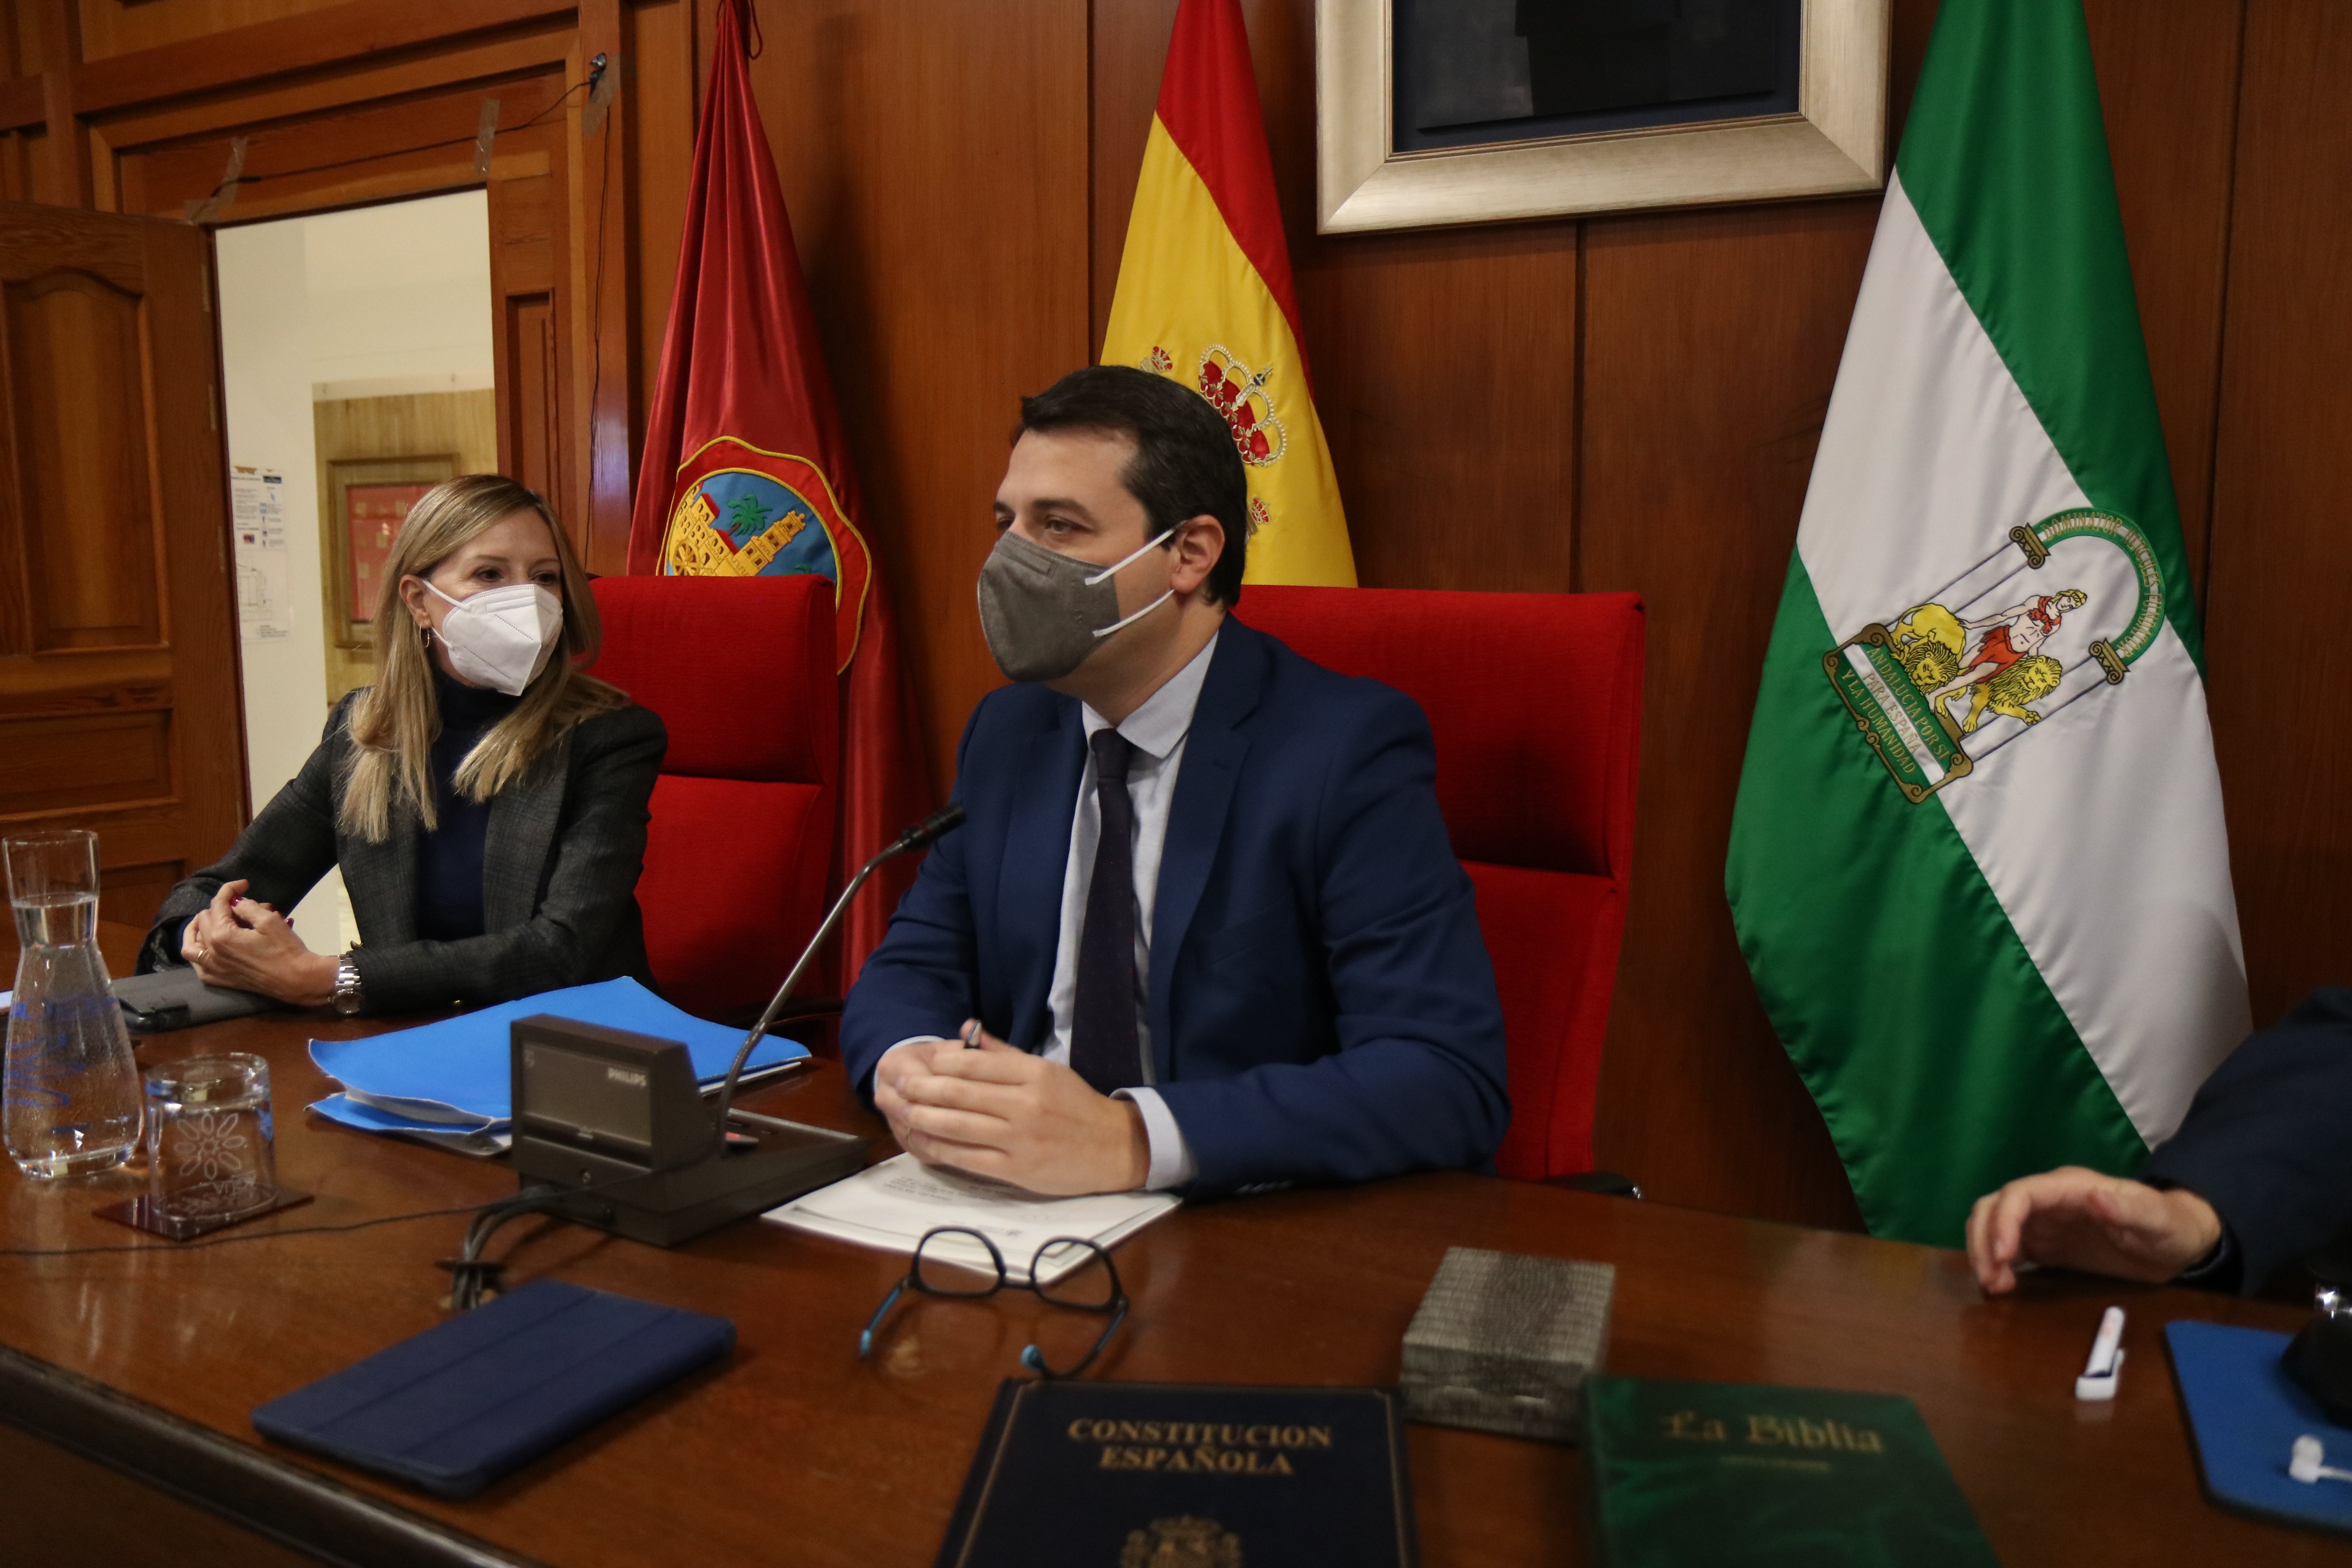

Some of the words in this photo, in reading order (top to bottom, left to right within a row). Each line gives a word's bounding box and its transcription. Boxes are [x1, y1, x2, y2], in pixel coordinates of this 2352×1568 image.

[2040, 512, 2123, 540] DOMINATOR
[2122, 526, 2160, 587] HERCULES
[2118, 593, 2162, 657] FUNDATOR
[1842, 669, 1855, 679] Y
[1848, 679, 1865, 699] LA
[1863, 673, 1890, 704] PARA
[1886, 703, 1921, 753] ESPAÑA
[1867, 648, 1921, 718] ANDALUCIA
[1915, 716, 1939, 745] POR
[1934, 744, 1950, 760] SI
[1860, 697, 1916, 773] HUMANIDAD
[608, 1067, 647, 1087] PHILIPS
[1068, 1417, 1332, 1446] CONSTITUCION
[1662, 1409, 1726, 1442] La
[1747, 1414, 1884, 1452] Biblia
[1100, 1445, 1293, 1474] ESPAÑOLA
